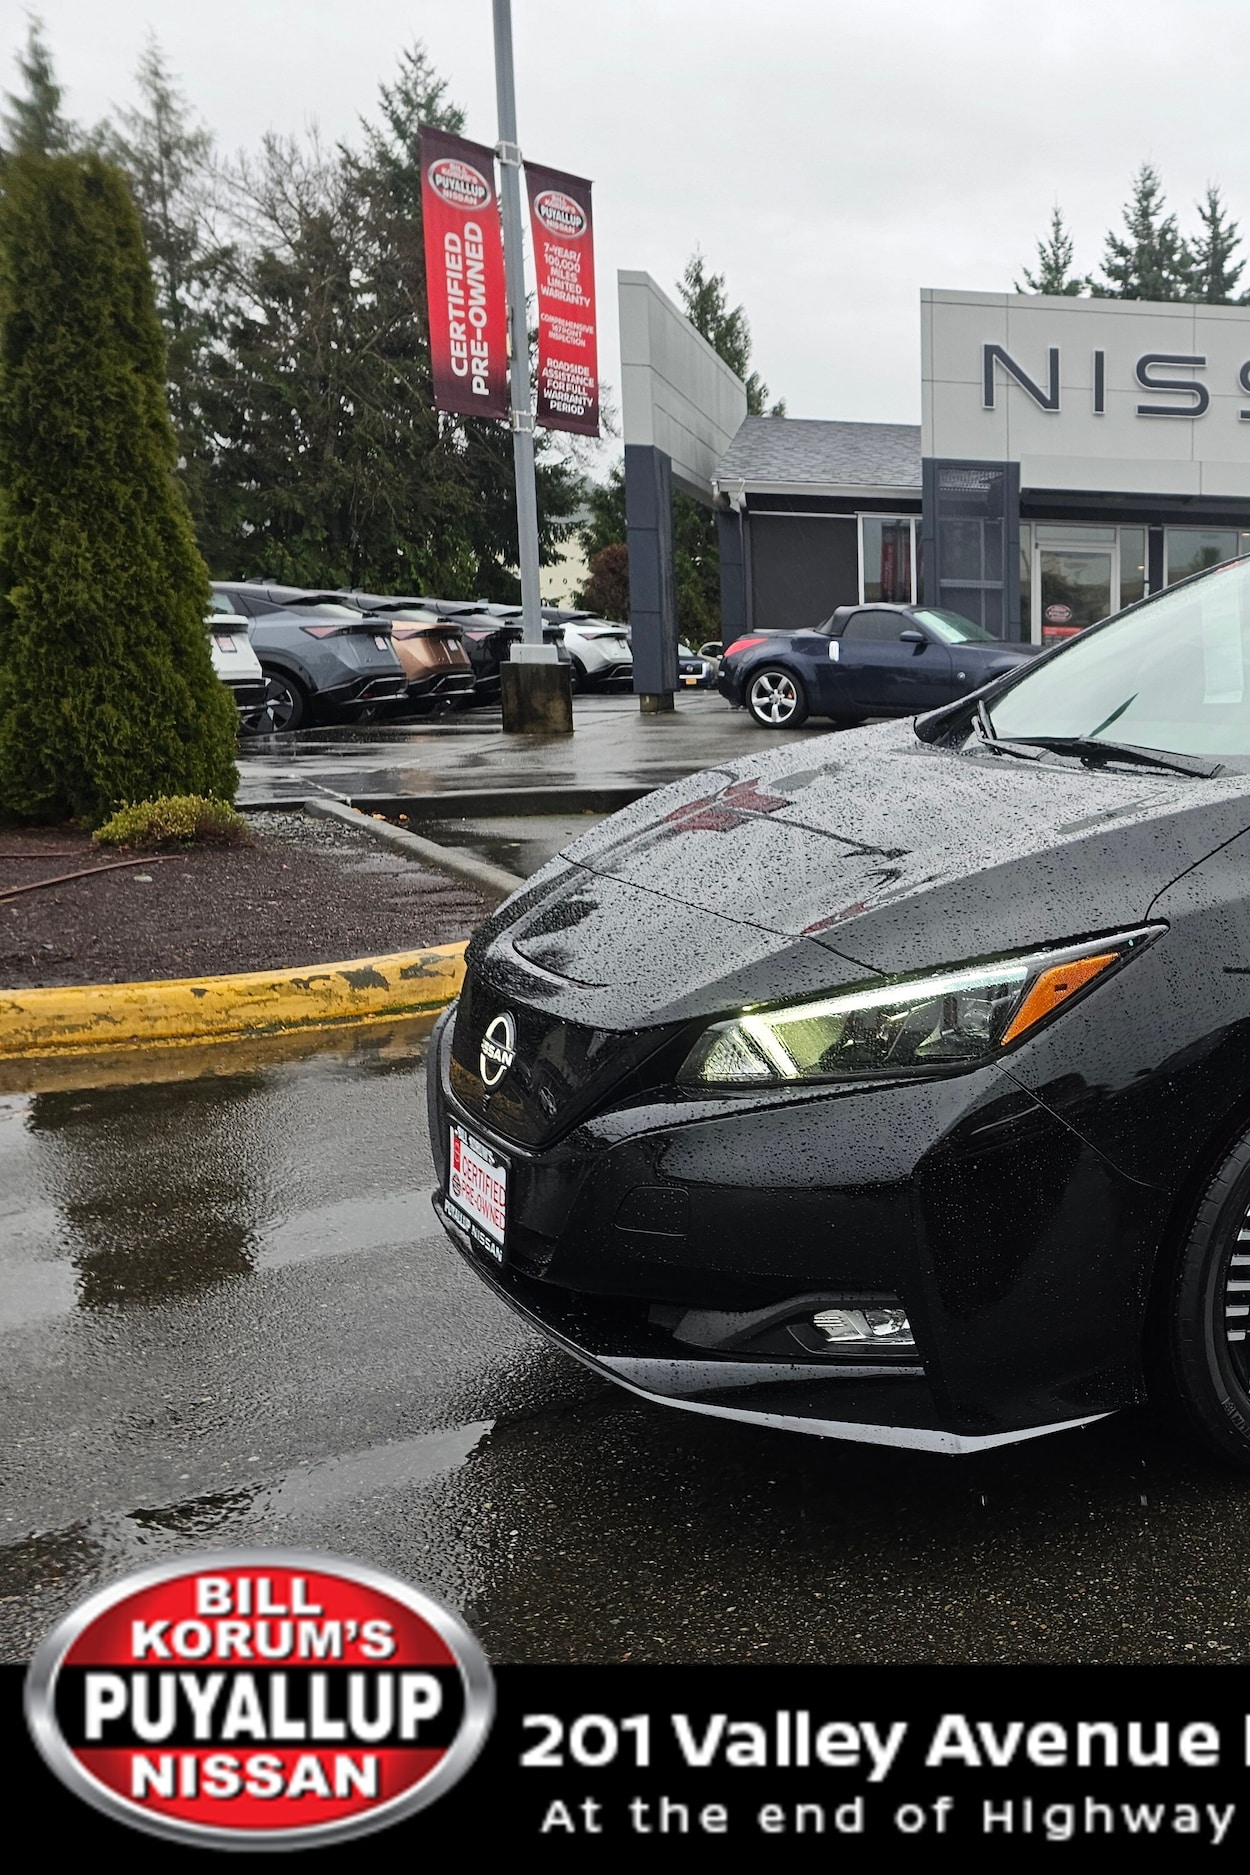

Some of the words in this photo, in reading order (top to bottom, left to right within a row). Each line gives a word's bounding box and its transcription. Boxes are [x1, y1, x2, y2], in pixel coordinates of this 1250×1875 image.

[435, 174, 485, 198] PUYALLUP
[541, 206, 582, 227] PUYALLUP
[544, 242, 581, 262] 7-YEAR/
[544, 254, 581, 273] 100,000
[550, 266, 578, 282] MILES
[547, 276, 582, 295] LIMITED
[444, 232, 468, 377] CERTIFIED
[540, 285, 591, 308] WARRANTY
[464, 221, 490, 396] PRE-OWNED
[540, 313, 594, 334] COMPREHENSIVE
[548, 331, 586, 348] INSPECTION
[542, 367, 594, 388] ASSISTANCE
[547, 358, 590, 377] ROADSIDE
[543, 388, 593, 408] WARRANTY
[547, 379, 565, 392] FOR
[566, 382, 588, 396] FULL
[550, 401, 585, 416] PERIOD
[462, 1155, 506, 1207] CERTIFIED
[461, 1180, 506, 1230] PRE-OWNED
[471, 1225, 503, 1262] NISSAN
